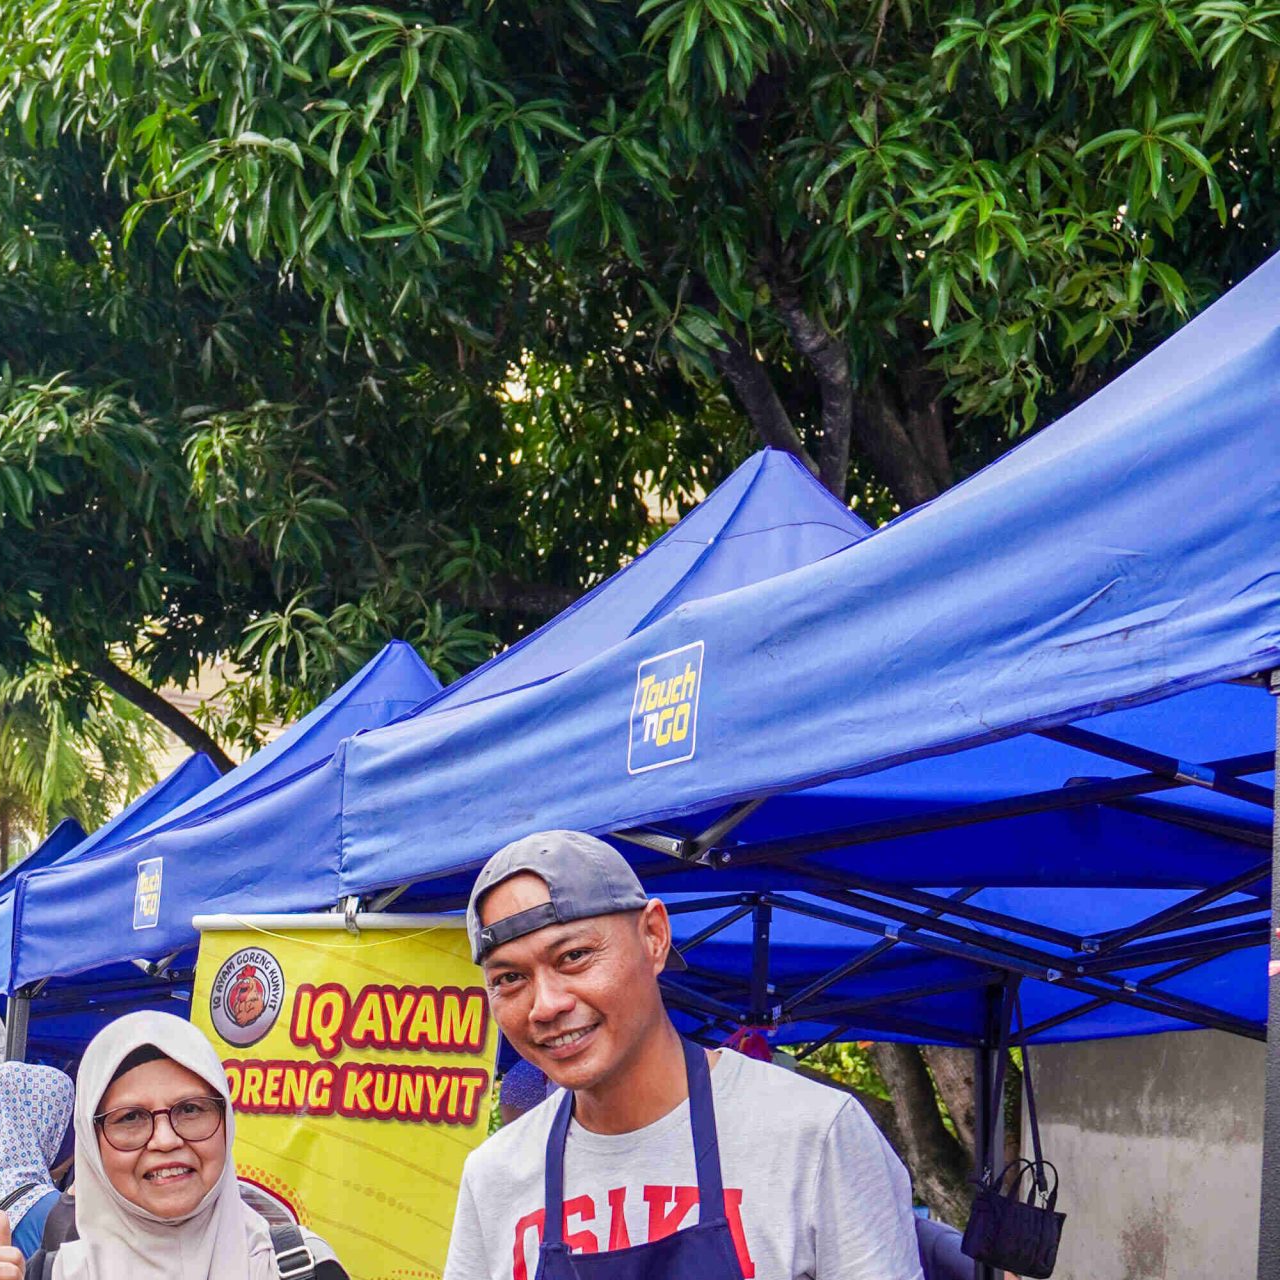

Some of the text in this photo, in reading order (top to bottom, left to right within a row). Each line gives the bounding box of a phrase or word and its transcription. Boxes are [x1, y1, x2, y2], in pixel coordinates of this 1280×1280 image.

[639, 662, 696, 714] Touch
[213, 952, 280, 1012] IQ AYAM GORENG KUNYIT
[294, 989, 483, 1051] IQ AYAM
[224, 1066, 483, 1117] ORENG KUNYIT
